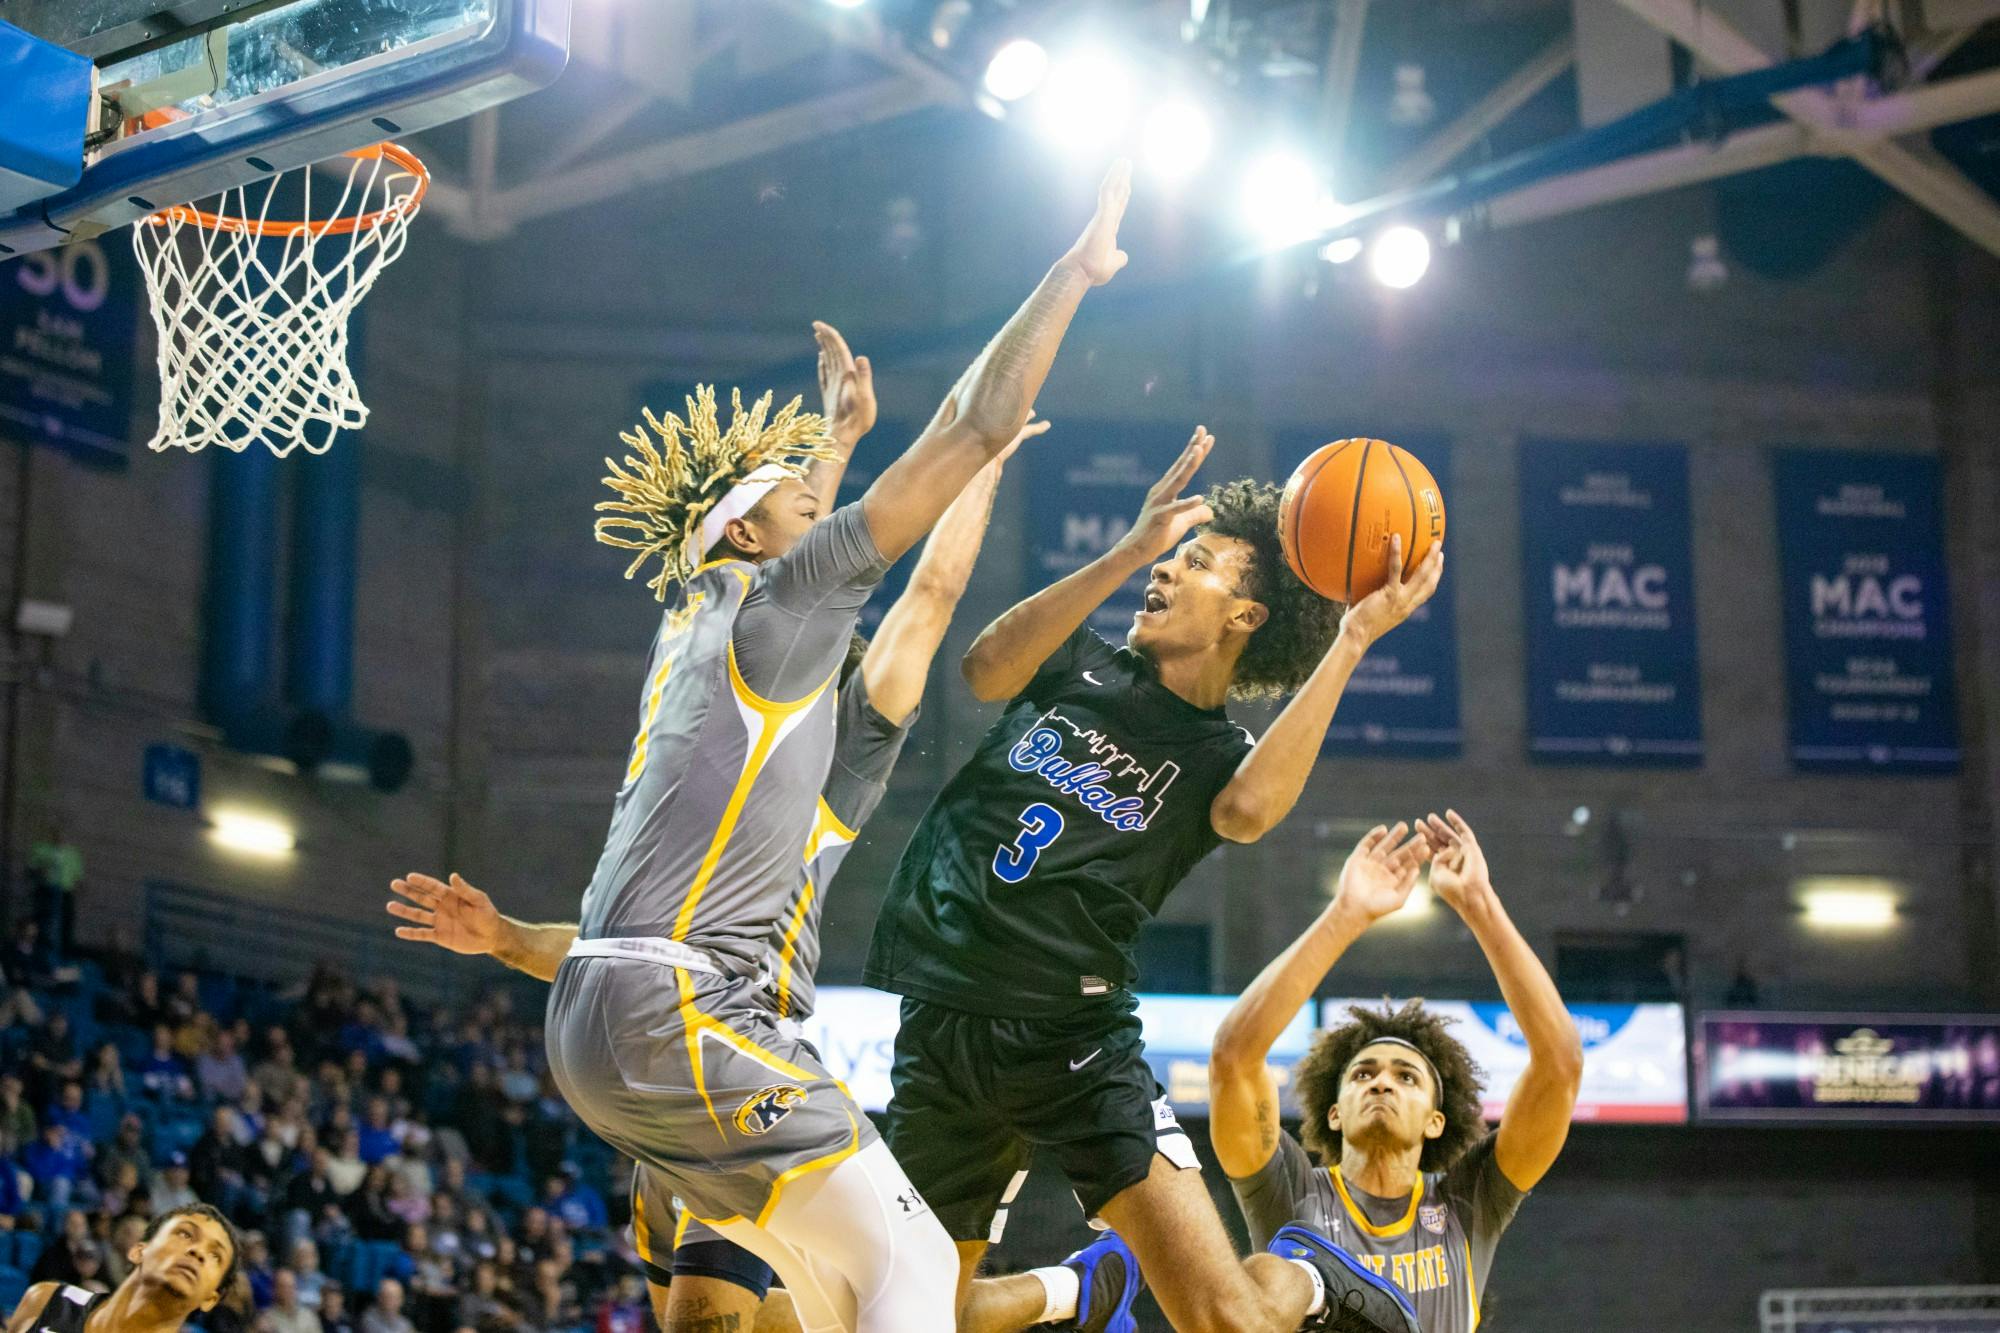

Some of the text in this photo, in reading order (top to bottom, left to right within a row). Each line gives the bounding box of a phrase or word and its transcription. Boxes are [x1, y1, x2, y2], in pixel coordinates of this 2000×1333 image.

[1553, 564, 1669, 608] MAC
[1811, 575, 1923, 618] MAC
[1008, 727, 1148, 832] Buffalo
[992, 802, 1065, 884] 3
[1391, 1244, 1449, 1294] STATE
